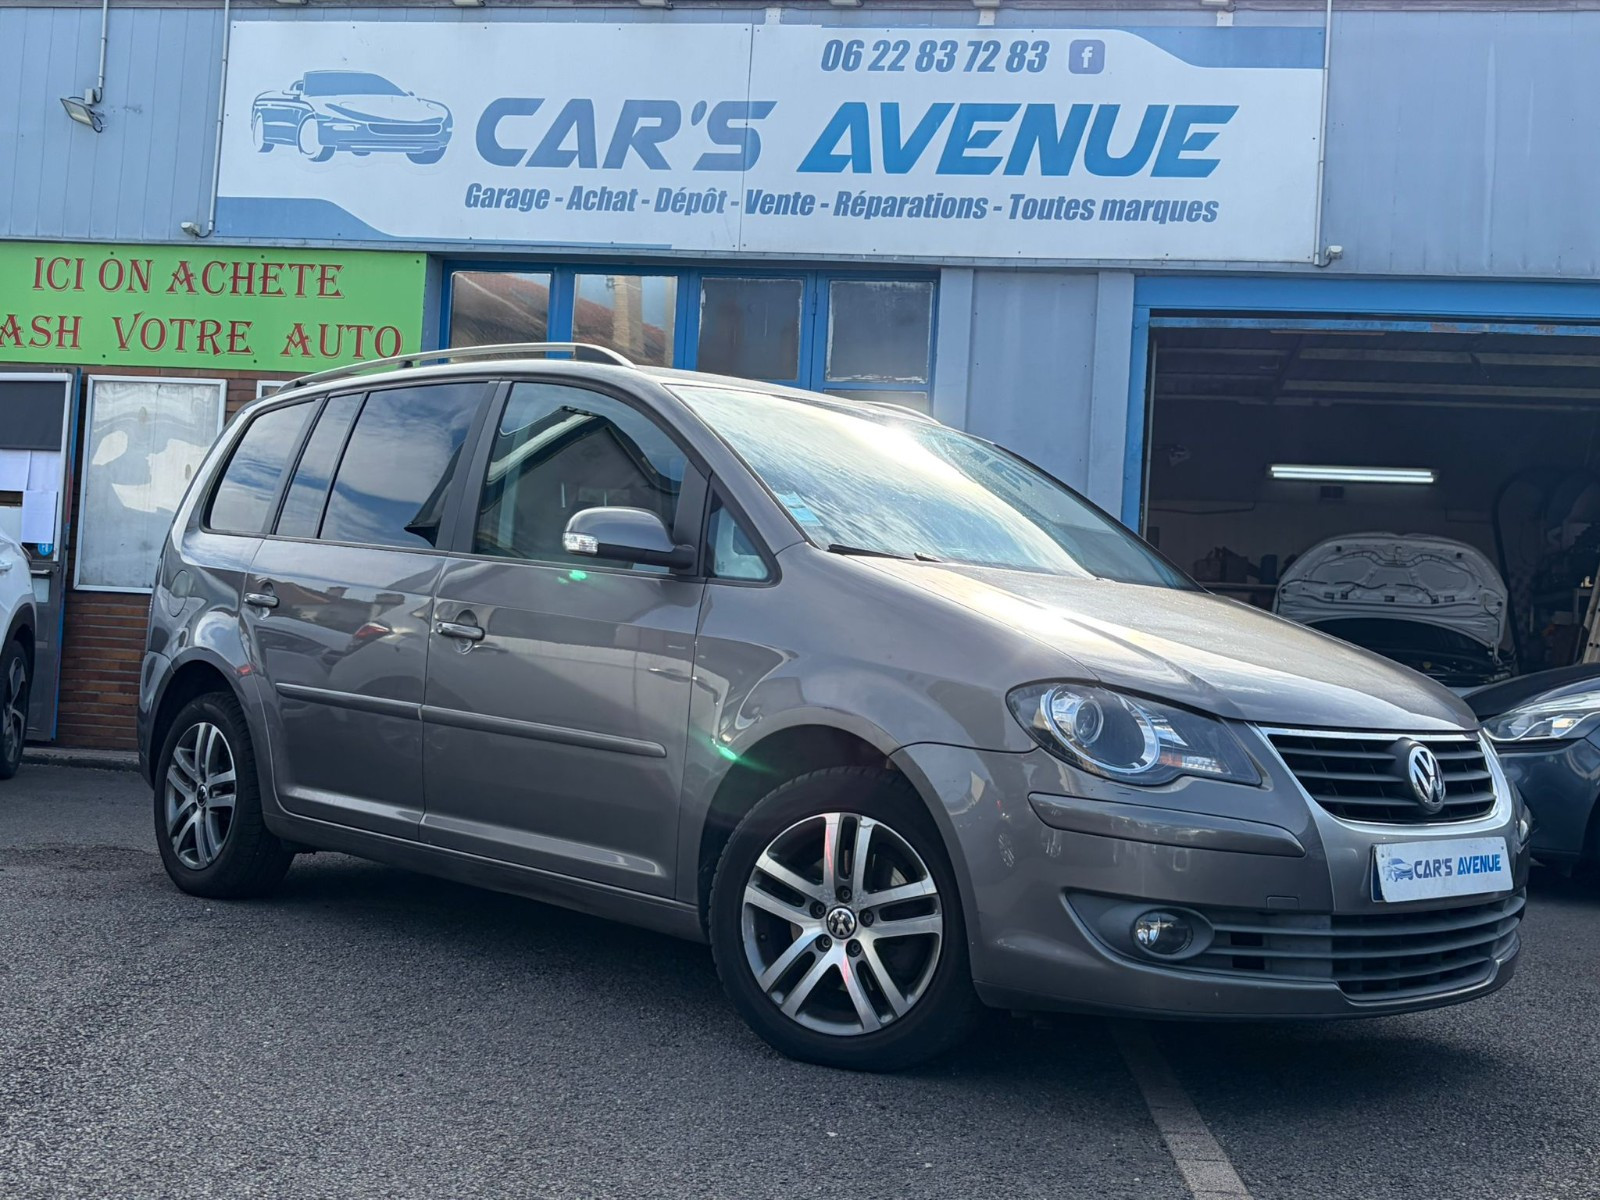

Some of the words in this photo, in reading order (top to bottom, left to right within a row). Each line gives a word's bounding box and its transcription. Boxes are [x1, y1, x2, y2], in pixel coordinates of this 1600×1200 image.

[820, 39, 865, 72] 06
[867, 39, 911, 72] 22
[914, 40, 959, 73] 83
[962, 40, 1002, 73] 72
[1004, 40, 1051, 73] 83
[475, 97, 778, 172] CAR'S
[796, 101, 1240, 178] AVENUE
[464, 182, 551, 213] Garage
[565, 185, 639, 212] Achat
[653, 186, 728, 216] Dépôt
[744, 188, 816, 217] Vente
[832, 189, 989, 220] Réparations
[1008, 193, 1098, 222] Toutes
[1099, 198, 1220, 225] marques
[32, 256, 86, 292] ICI
[98, 257, 154, 294] ON
[165, 259, 346, 299] ACHETE
[111, 310, 256, 357] VOTRE
[279, 321, 404, 360] AUTO
[1413, 857, 1453, 879] CAR'S
[1457, 853, 1502, 876] AVENUE
